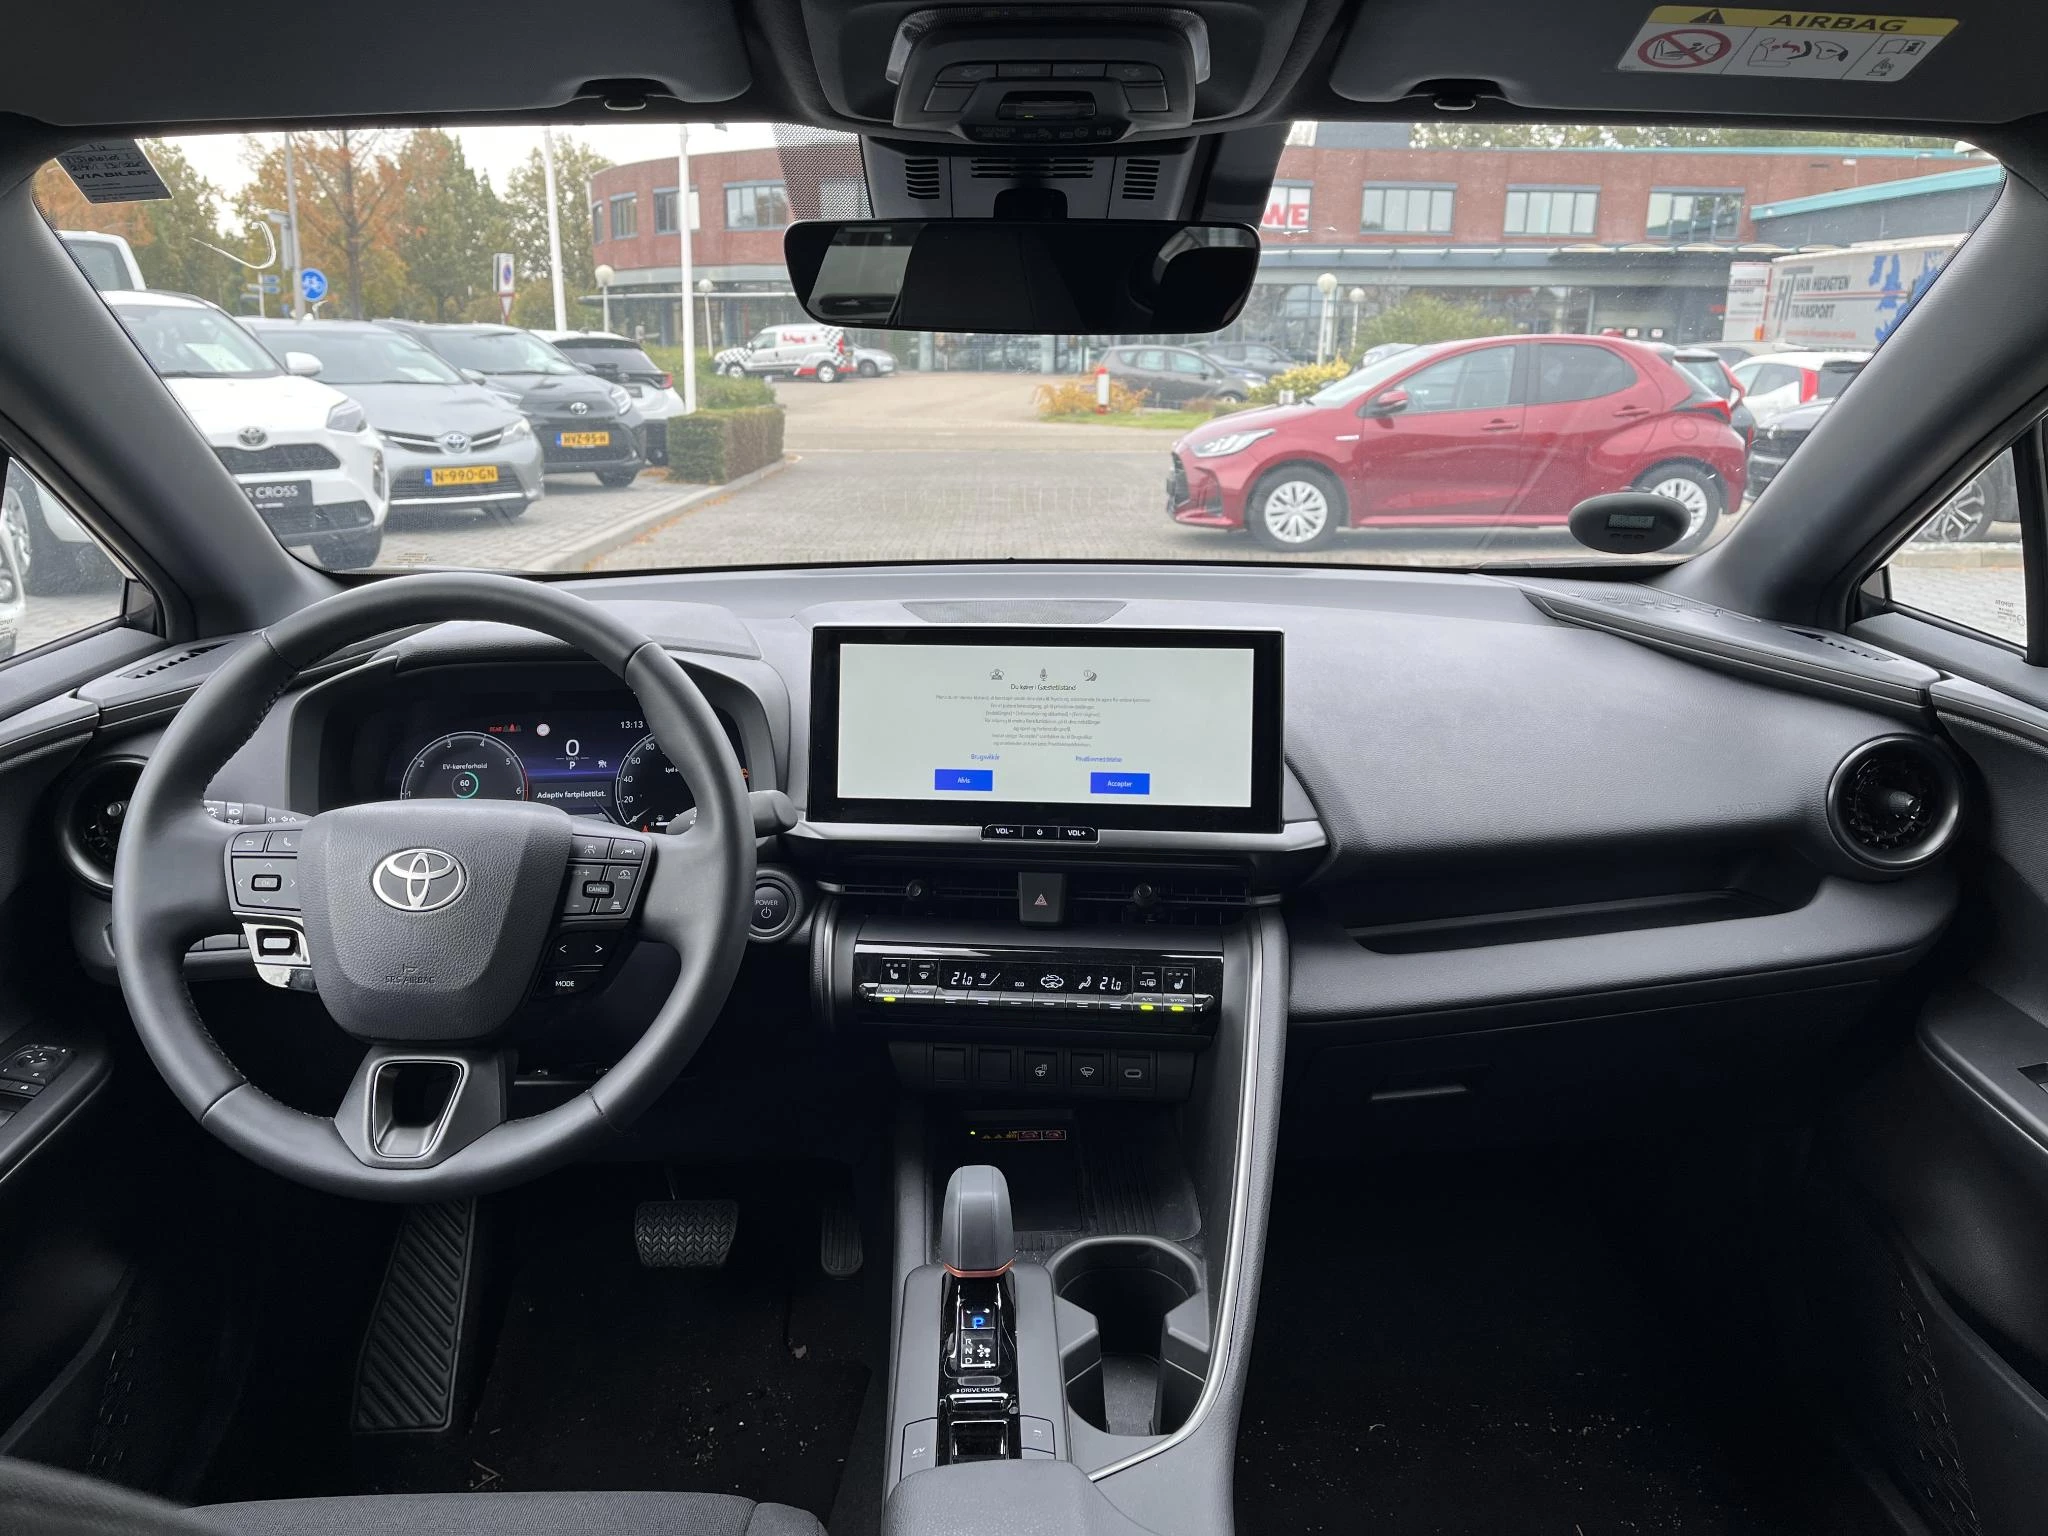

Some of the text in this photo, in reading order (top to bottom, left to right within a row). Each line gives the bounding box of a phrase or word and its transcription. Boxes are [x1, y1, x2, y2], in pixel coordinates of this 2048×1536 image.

[1768, 14, 1907, 32] AIRBAG
[1790, 303, 1836, 319] TRANSPORT
[435, 468, 496, 483] N-990-GN
[255, 485, 299, 499] CROSS
[620, 721, 644, 729] 13:13
[565, 739, 580, 756] 0
[645, 743, 655, 751] 80
[569, 761, 576, 769] P
[631, 757, 641, 765] 60
[623, 775, 634, 783] 40
[1107, 780, 1133, 788] Accepter
[515, 787, 521, 795] 6
[536, 790, 564, 799] Adaptiv
[385, 976, 436, 985] SRS AIRBAG
[972, 1316, 985, 1329] P
[965, 1338, 972, 1346] R
